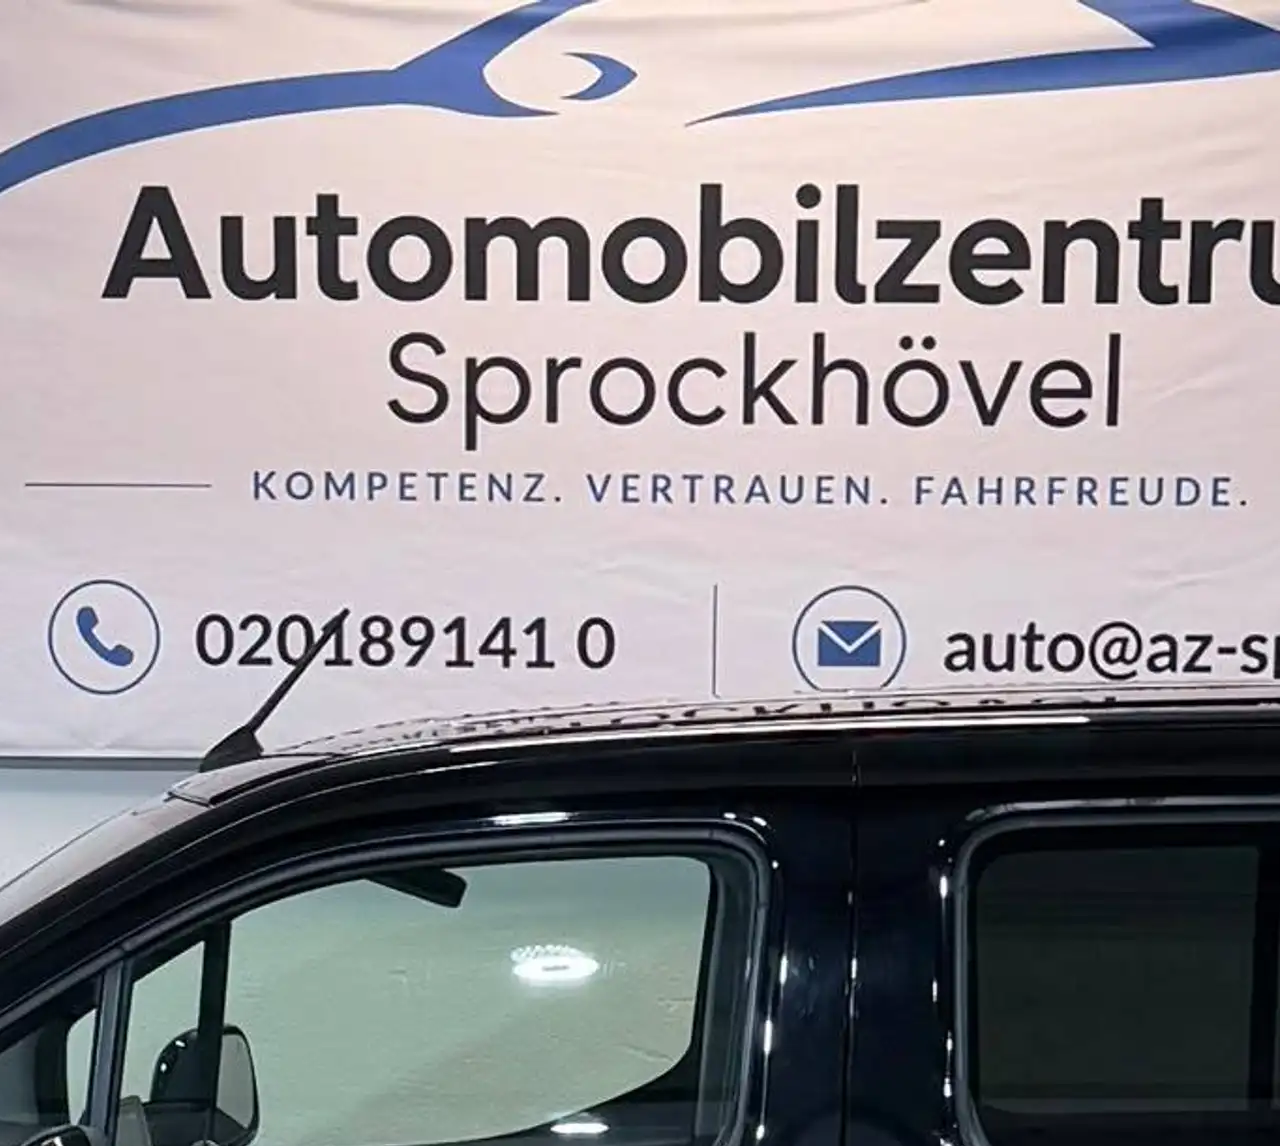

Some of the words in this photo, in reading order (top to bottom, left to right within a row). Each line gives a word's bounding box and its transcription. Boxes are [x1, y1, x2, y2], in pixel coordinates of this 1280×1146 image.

[387, 331, 1121, 452] Sprockhövel
[252, 470, 562, 504] KOMPETENZ.
[586, 472, 889, 506] VERTRAUEN.
[915, 475, 1248, 508] FAHRFREUDE.
